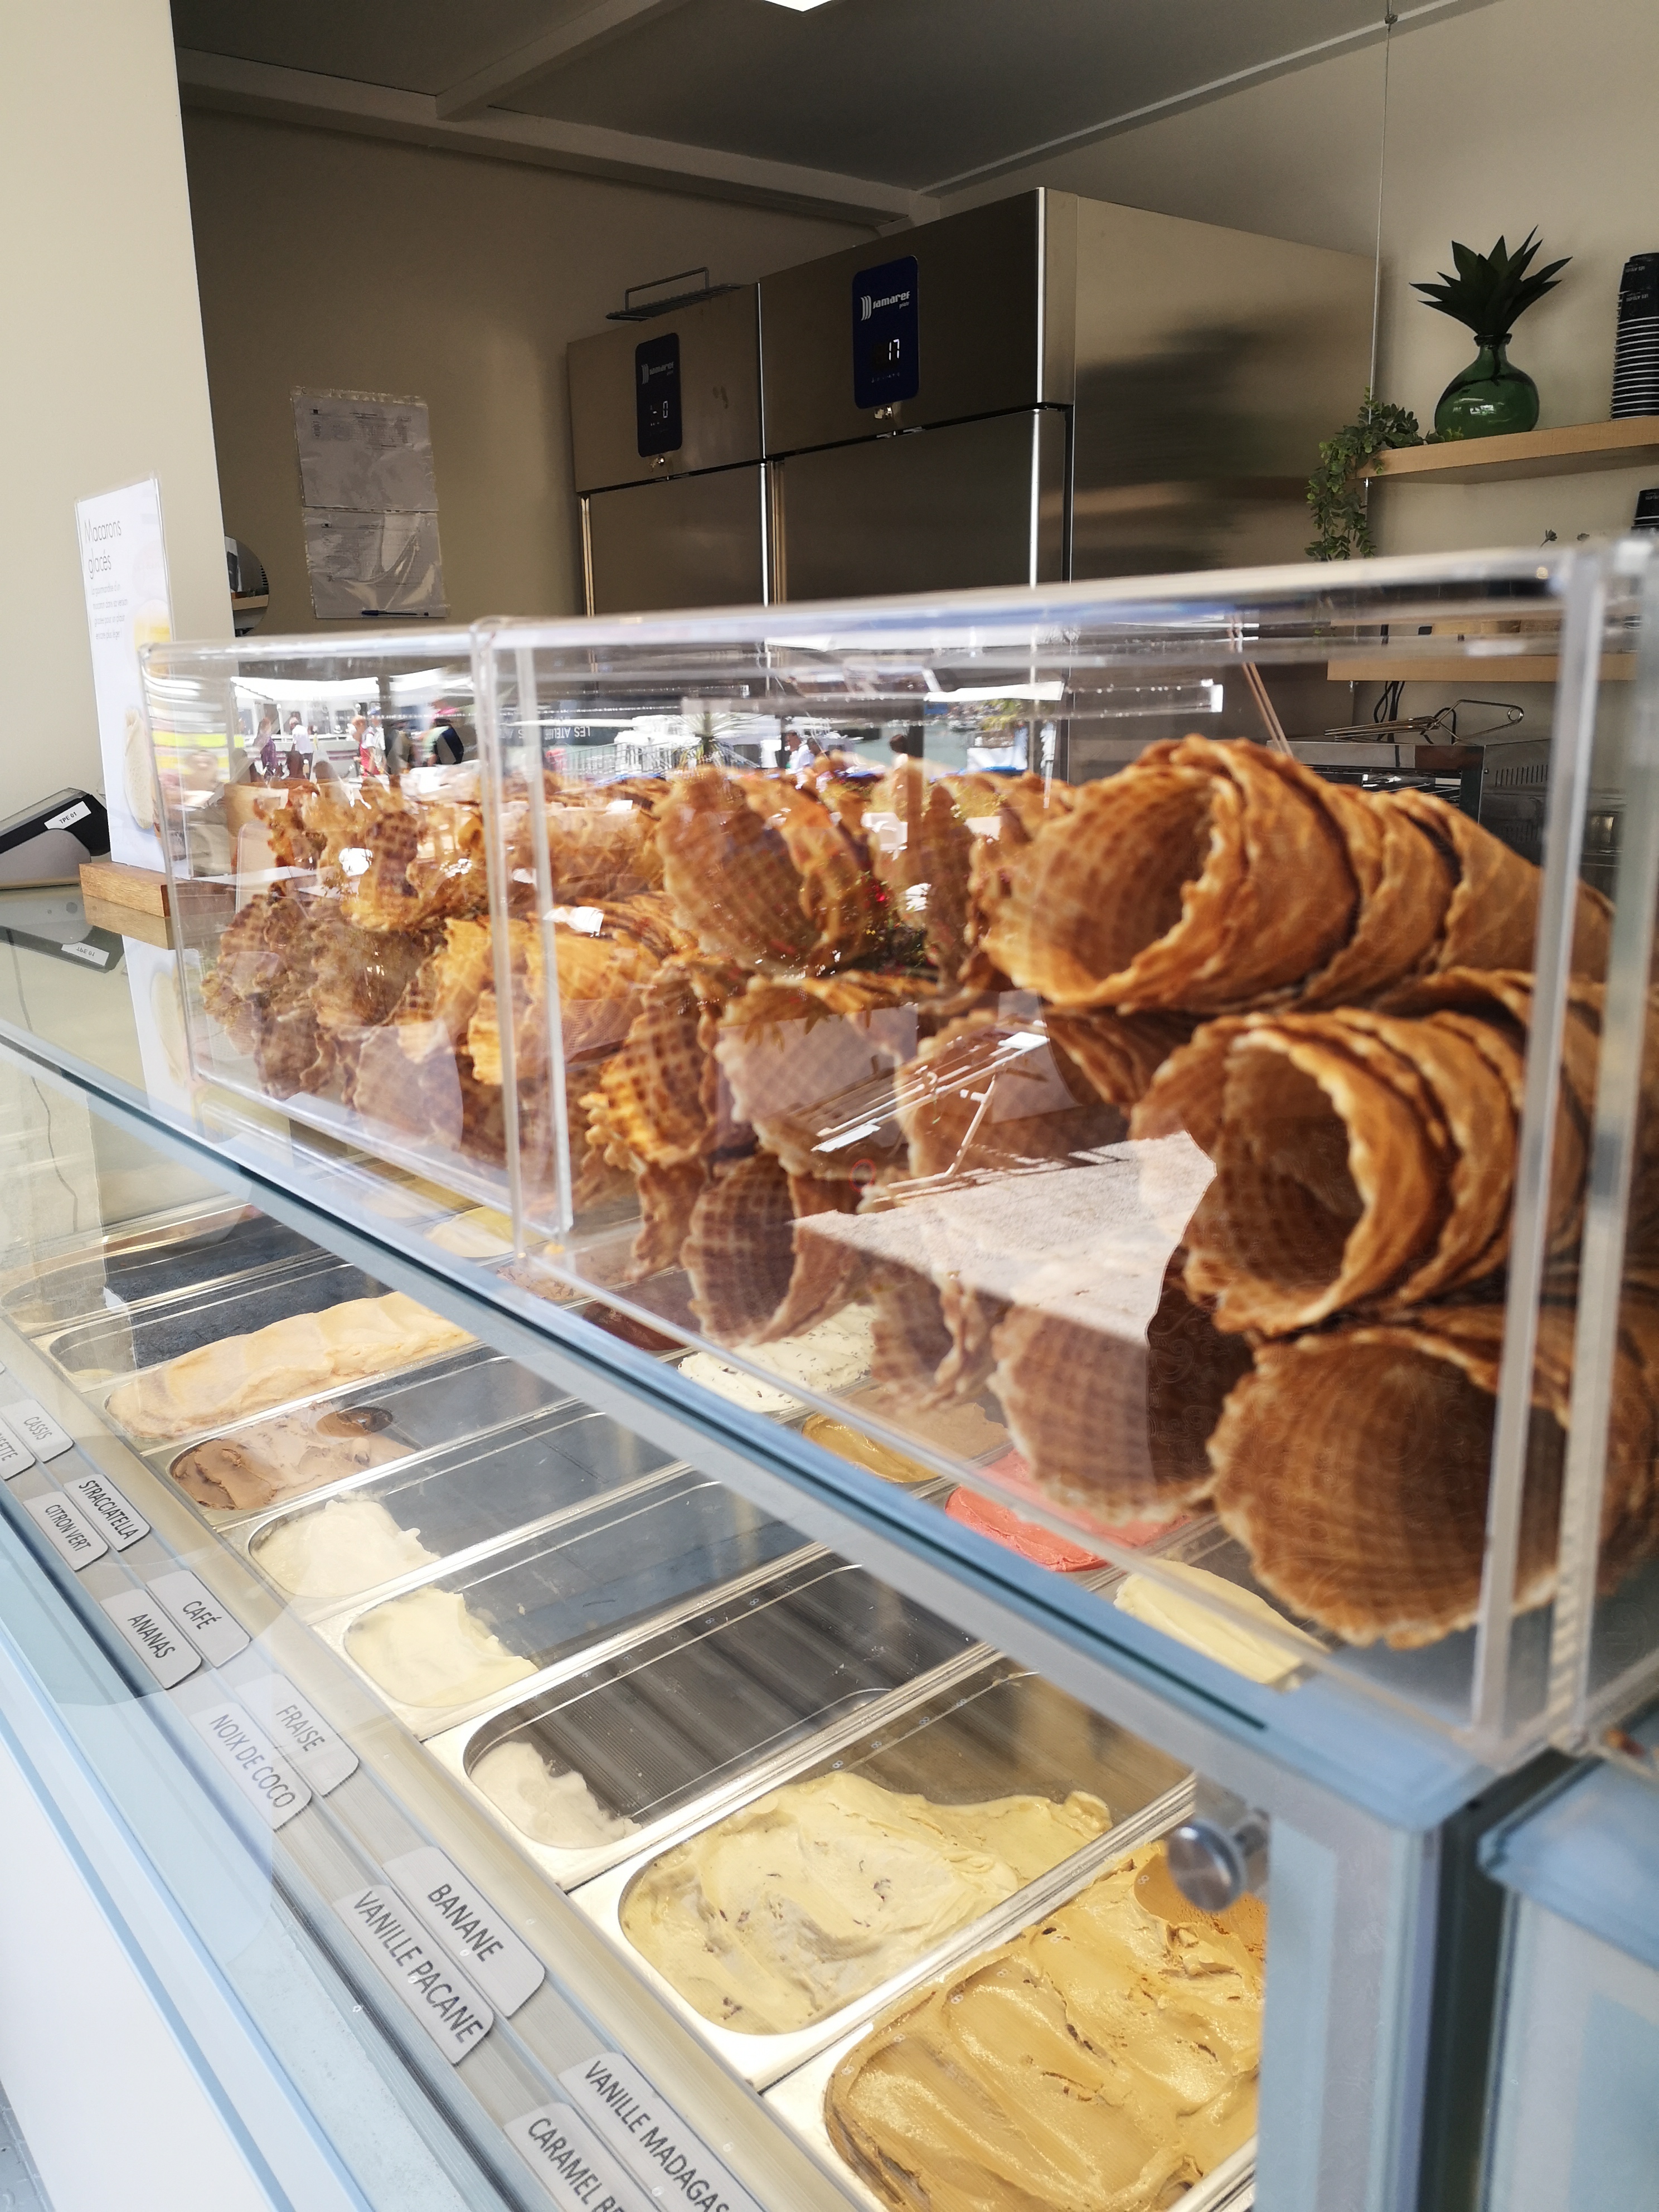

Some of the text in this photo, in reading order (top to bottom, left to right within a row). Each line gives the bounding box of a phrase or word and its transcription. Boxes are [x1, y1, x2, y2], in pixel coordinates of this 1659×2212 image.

[84, 518, 122, 544] Macarons
[88, 548, 111, 580] glacés
[59, 814, 71, 824] TPE
[23, 1417, 52, 1440] CASSIS
[45, 1504, 91, 1551] CITRON VERT
[79, 1480, 139, 1540] STRACCIATELLA
[128, 1613, 176, 1659] ANANAS
[182, 1600, 222, 1630] CAFÉ
[275, 1704, 325, 1752] FRAISE
[209, 1714, 295, 1808] NOIX DE COCO
[427, 1883, 504, 1962] BANANE
[354, 1890, 483, 2044] VANILLE PACANE
[585, 2060, 651, 2133] VANILLE
[528, 2118, 602, 2205] CARAMEL
